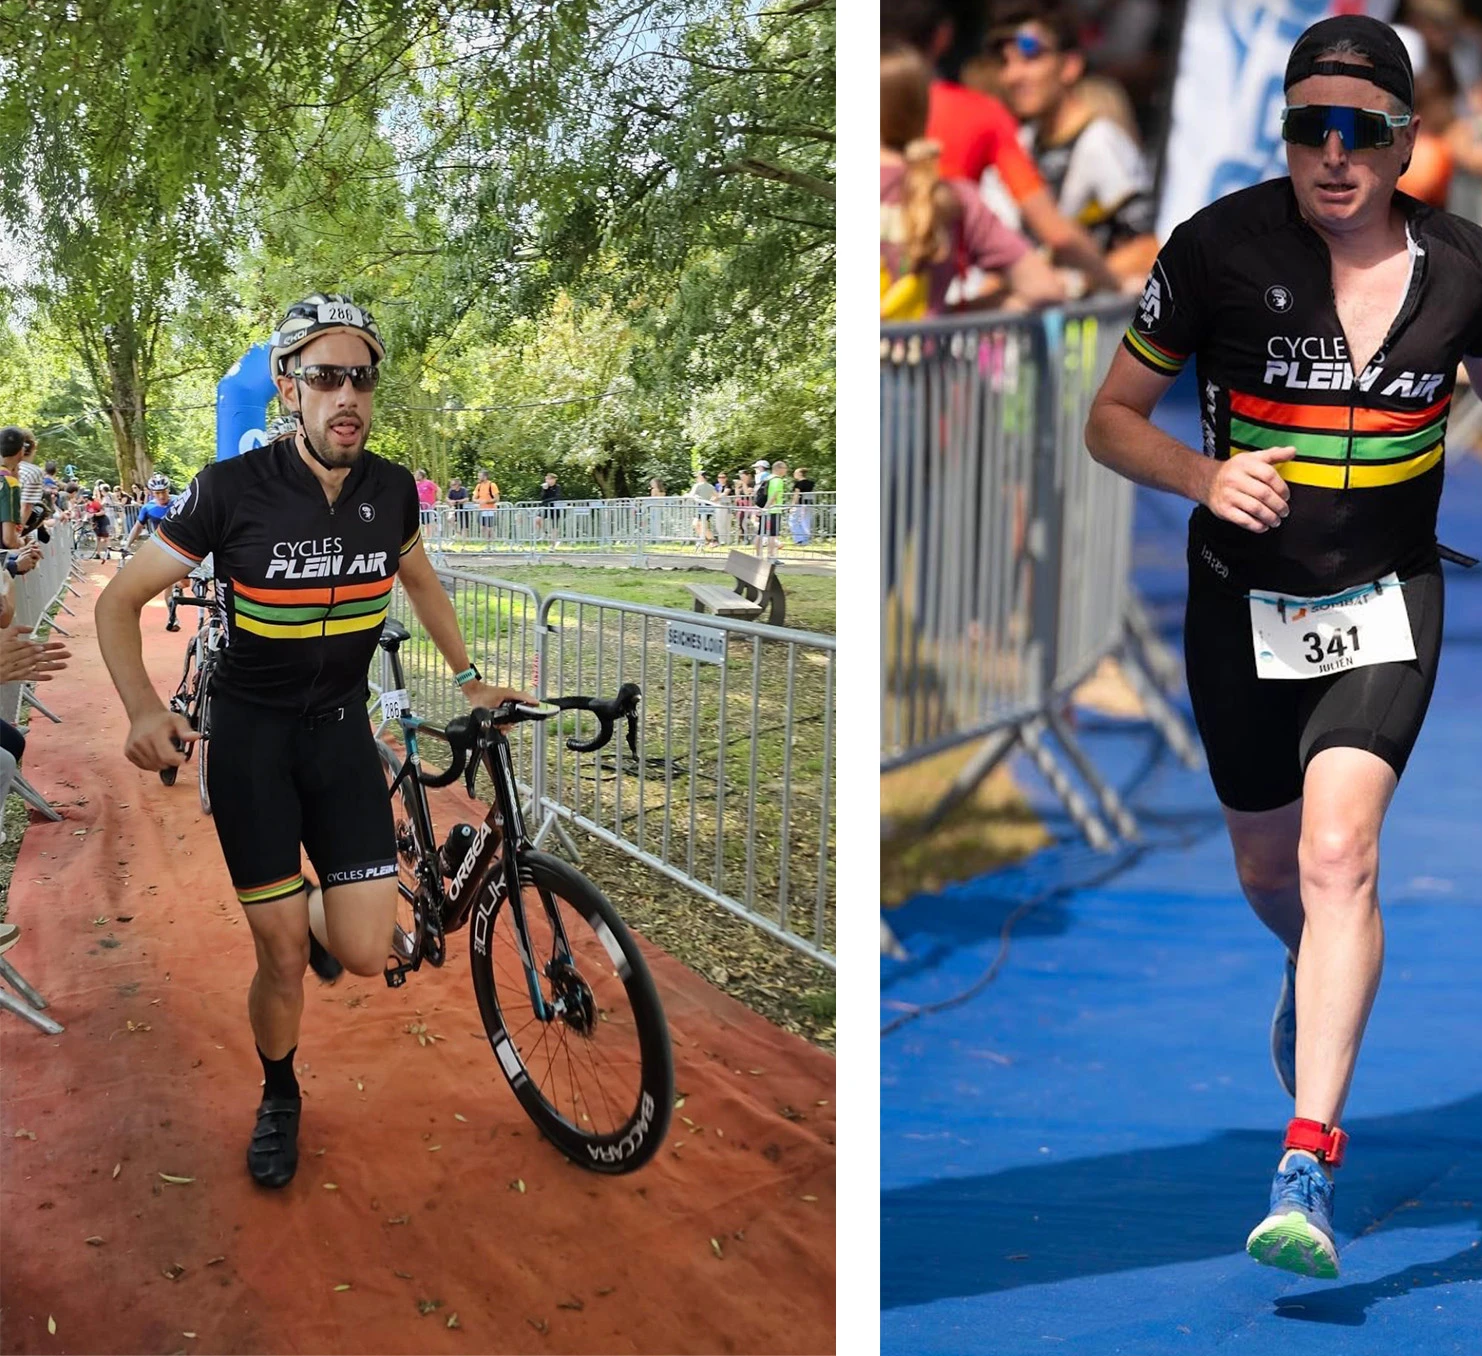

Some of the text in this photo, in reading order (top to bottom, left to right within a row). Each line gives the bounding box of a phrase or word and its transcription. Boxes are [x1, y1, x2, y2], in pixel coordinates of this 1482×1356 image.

[329, 307, 353, 321] 286
[1380, 371, 1446, 403] AIR
[272, 537, 343, 558] CYCLES
[265, 551, 388, 579] PLEIN AIR
[1303, 625, 1360, 664] 341
[1319, 657, 1354, 674] JULIEN
[385, 701, 400, 719] 286
[449, 821, 492, 901] ORBEA
[327, 869, 364, 882] CYCLES
